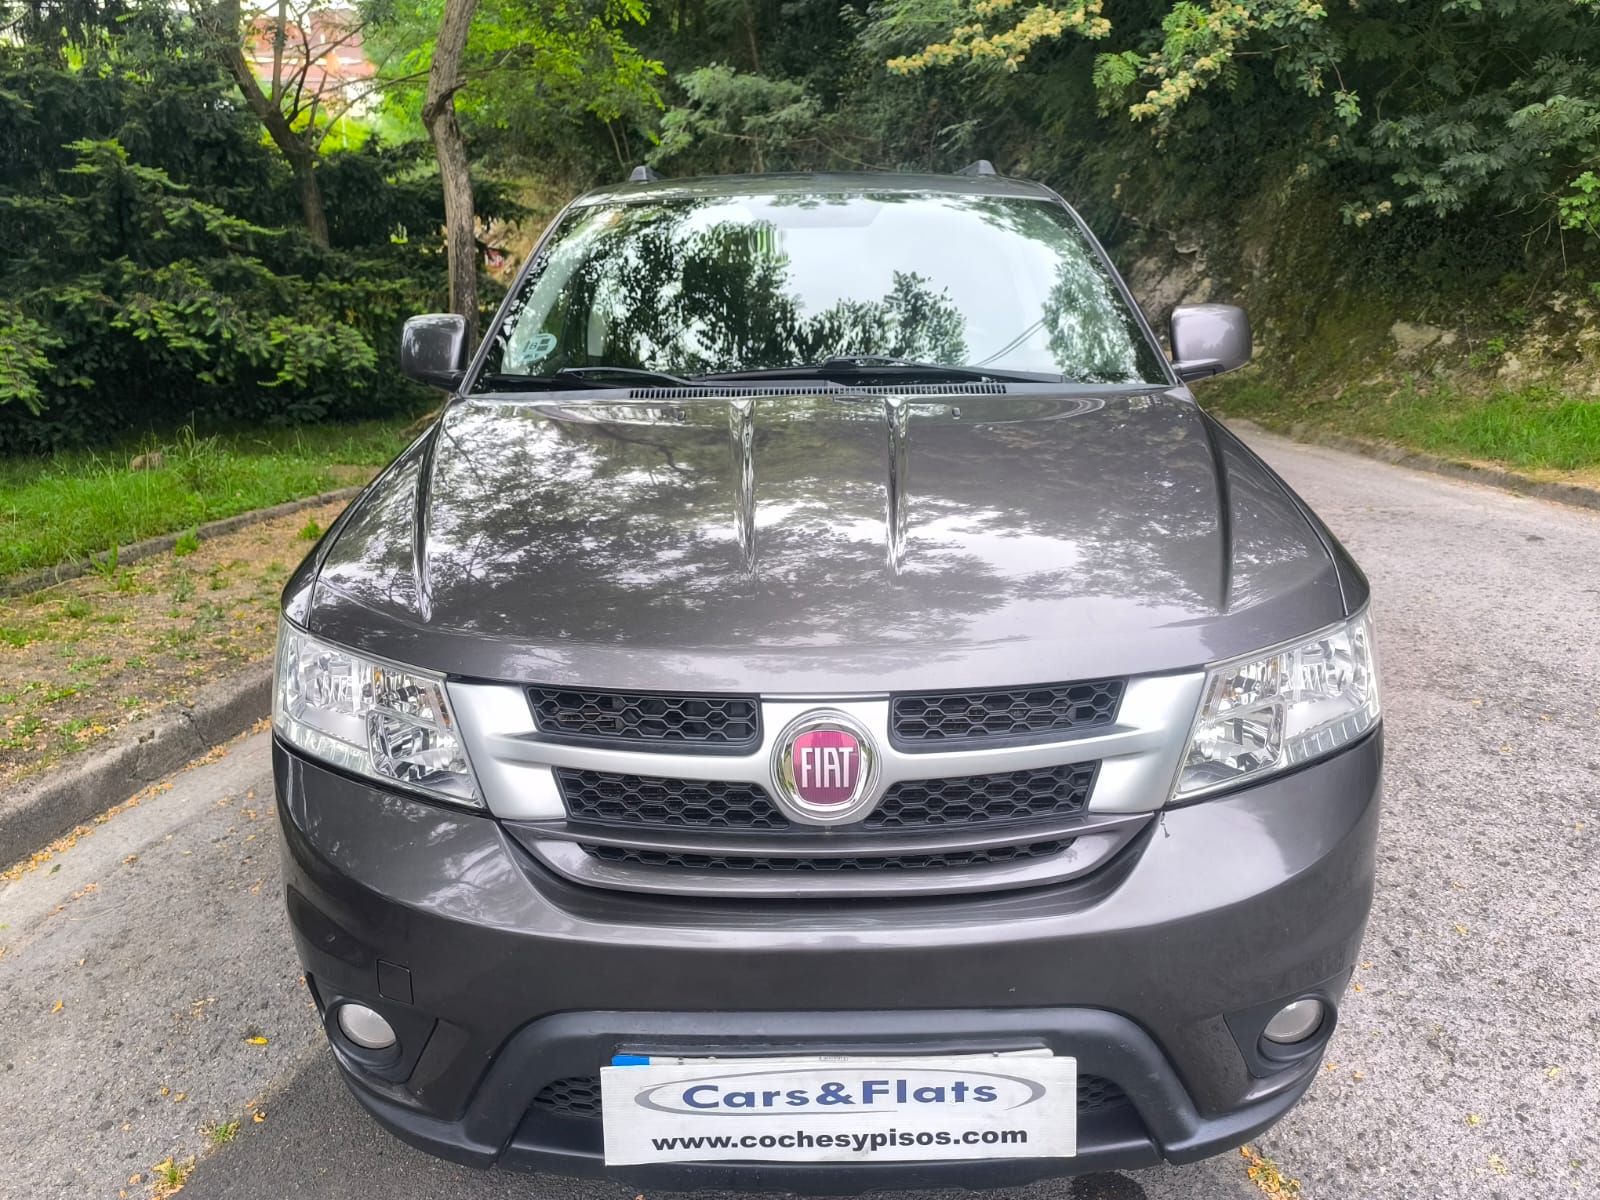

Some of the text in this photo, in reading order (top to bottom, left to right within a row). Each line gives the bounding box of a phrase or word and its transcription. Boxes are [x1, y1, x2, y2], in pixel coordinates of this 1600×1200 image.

[800, 747, 854, 788] FIAT
[682, 1080, 998, 1109] Cars&Flats
[651, 1128, 1028, 1152] www.cochesypisos.com
